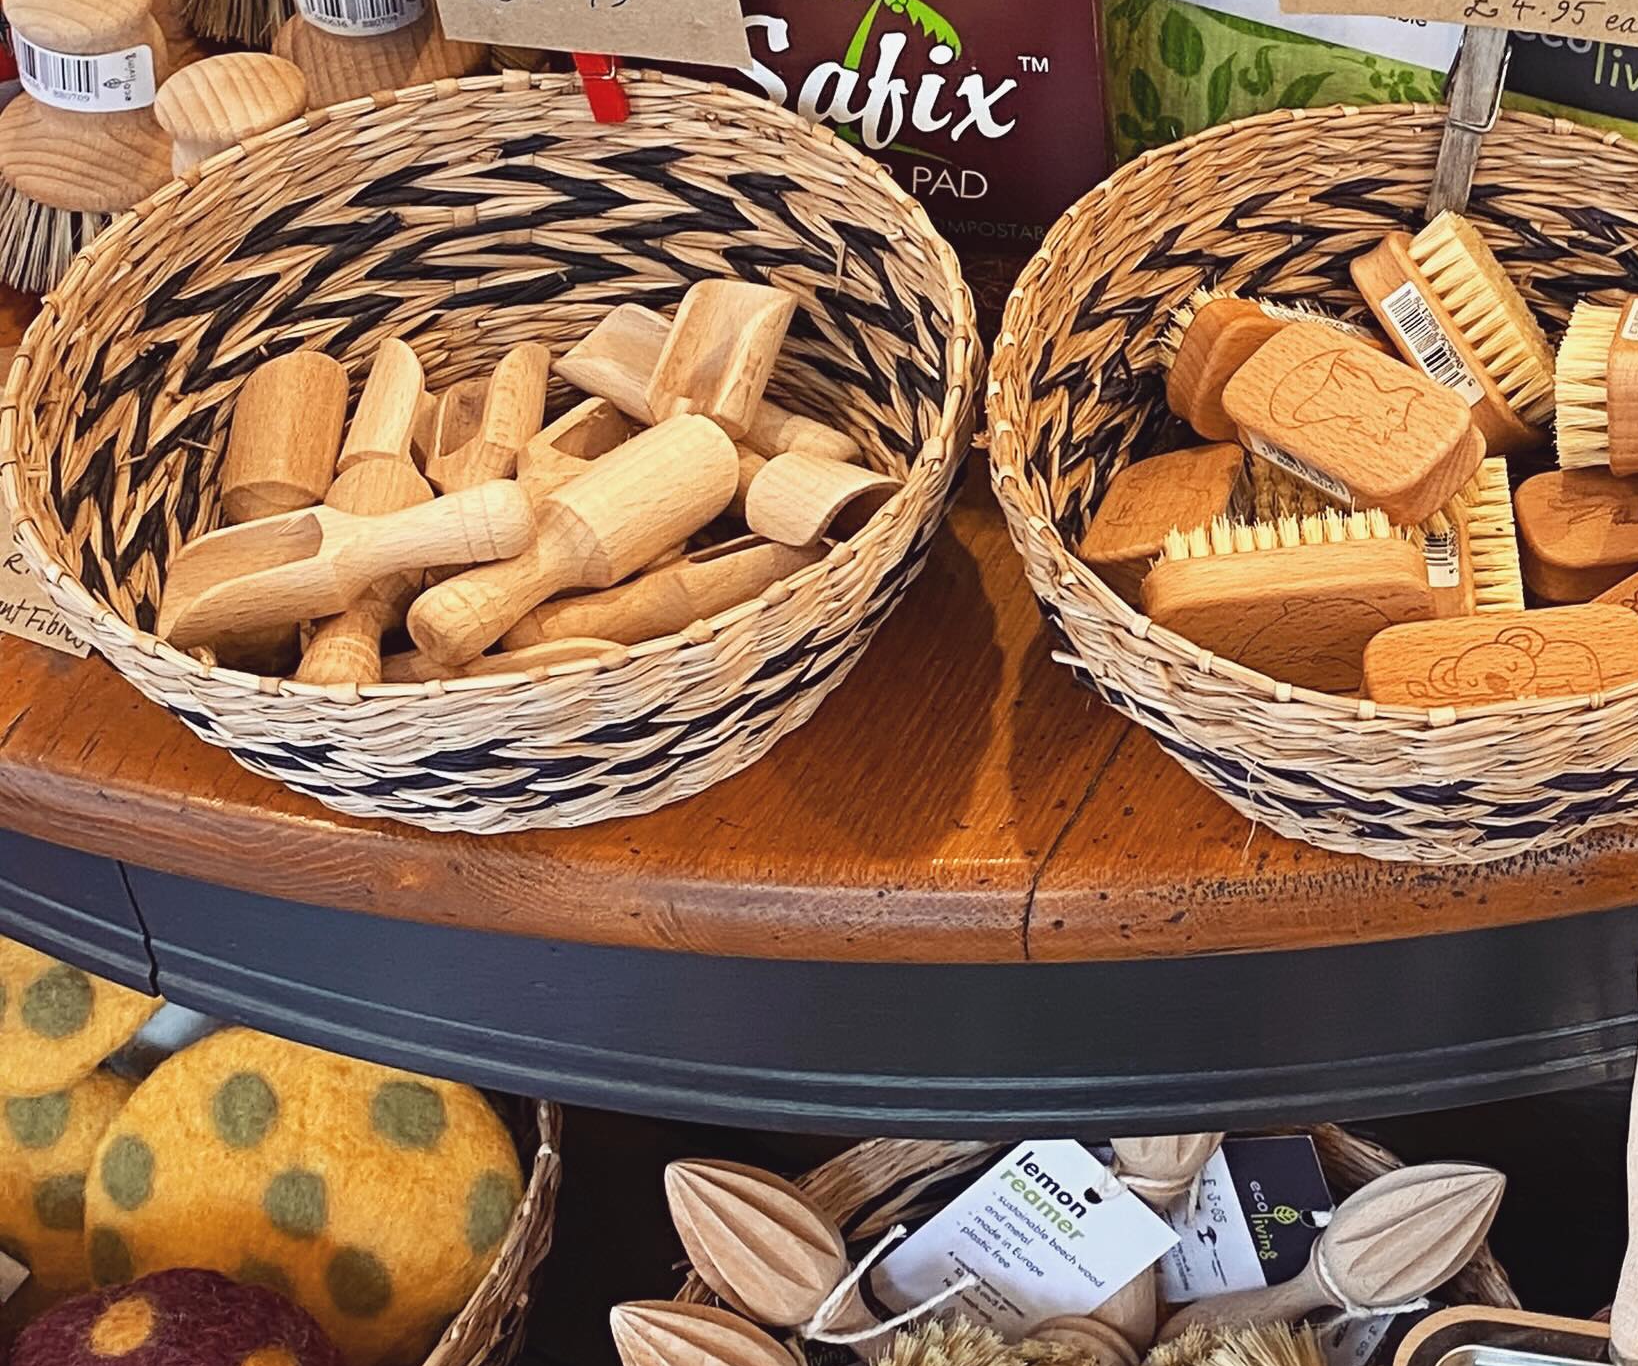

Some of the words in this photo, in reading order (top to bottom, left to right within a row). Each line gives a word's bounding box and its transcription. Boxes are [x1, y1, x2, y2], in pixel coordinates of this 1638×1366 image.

[911, 165, 989, 200] PAD
[999, 1169, 1086, 1242] reamer
[1015, 1150, 1088, 1220] lemon
[960, 1225, 991, 1254] plastic
[991, 1248, 1011, 1270] free
[973, 1214, 1002, 1241] made
[1011, 1245, 1046, 1278] Europe
[984, 1204, 1005, 1223] and
[1004, 1218, 1034, 1247] metal
[997, 1194, 1049, 1242] sustainable
[1048, 1238, 1077, 1266] beech
[1077, 1262, 1107, 1288] wood
